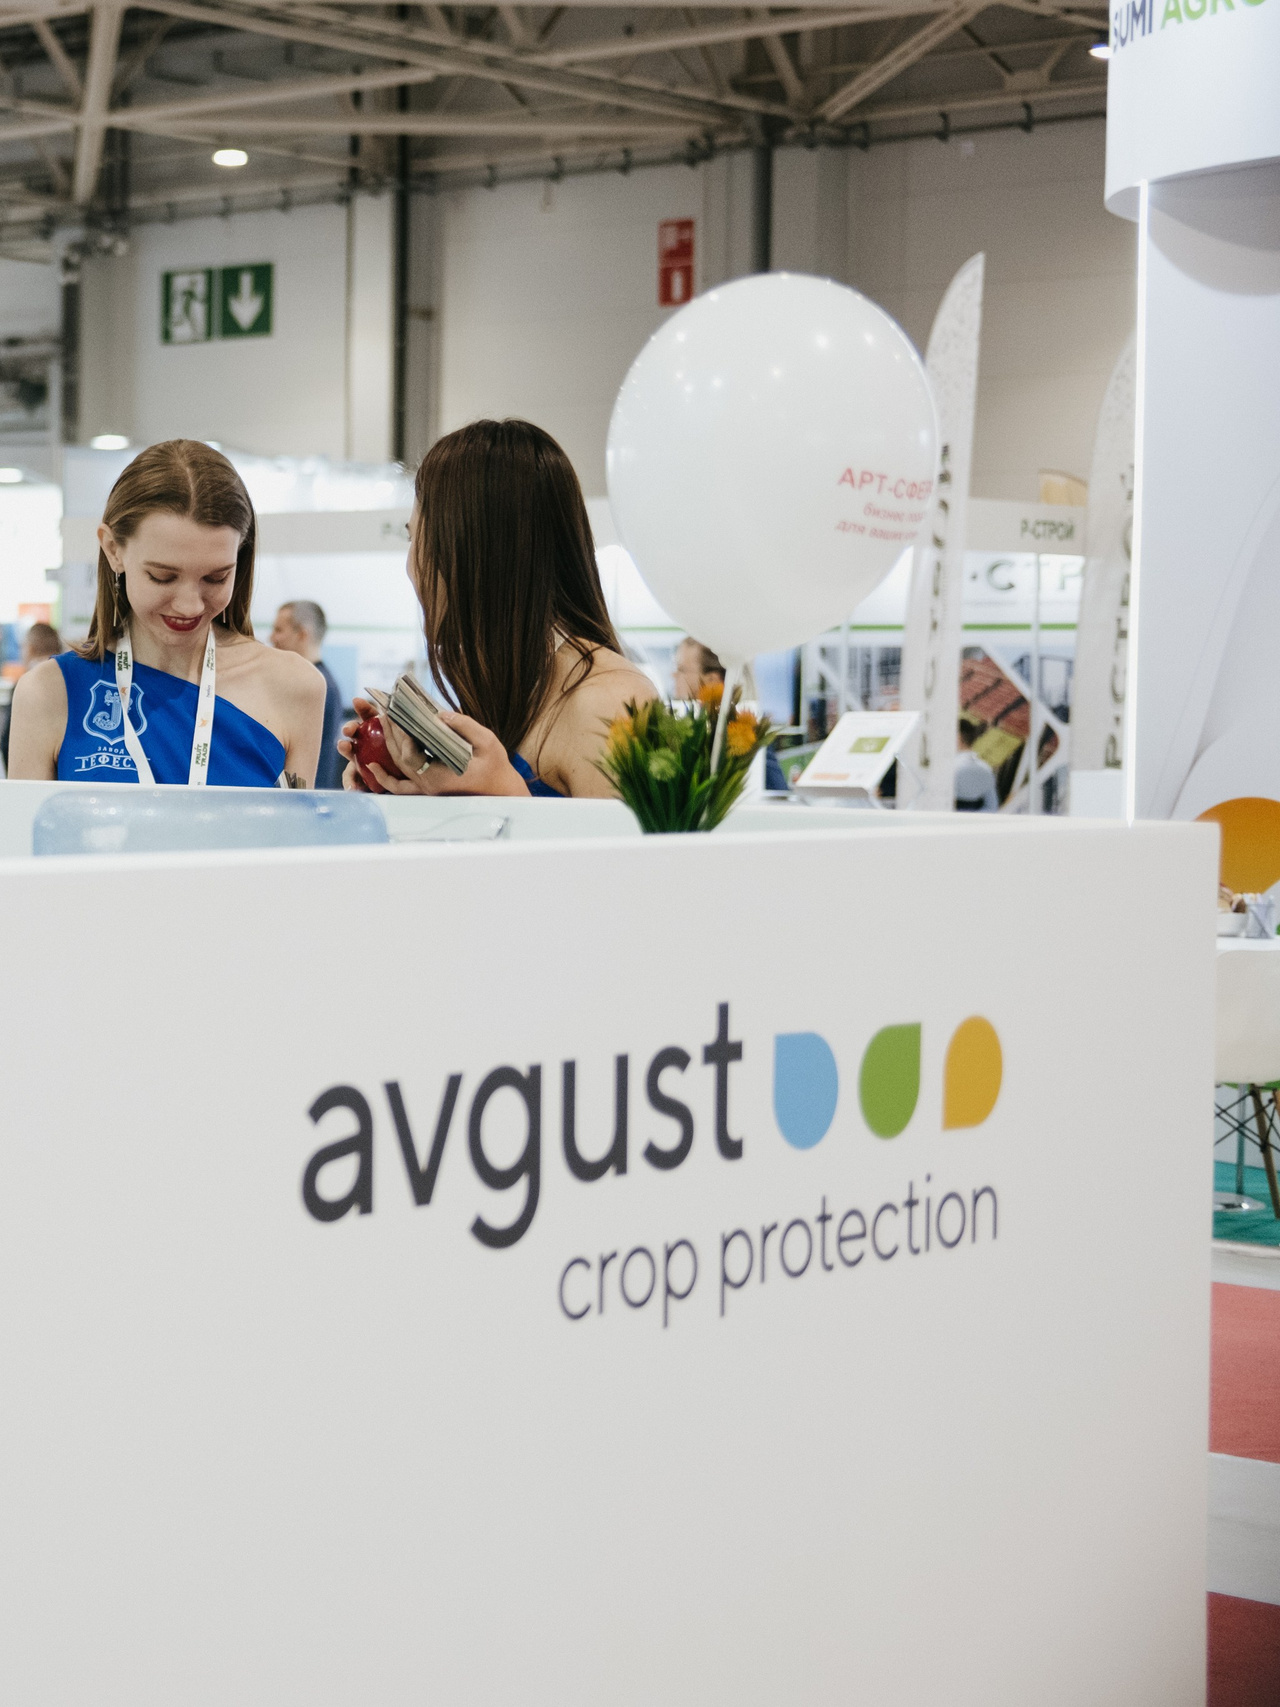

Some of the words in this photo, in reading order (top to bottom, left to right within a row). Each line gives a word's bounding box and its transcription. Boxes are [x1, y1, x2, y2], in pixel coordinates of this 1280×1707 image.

[1113, 0, 1154, 53] SUMI
[81, 754, 132, 769] ГЕФЕС
[97, 746, 125, 755] ЗАВОД
[301, 1001, 743, 1250] avgust
[558, 1237, 699, 1329] crop
[720, 1173, 999, 1318] protection
